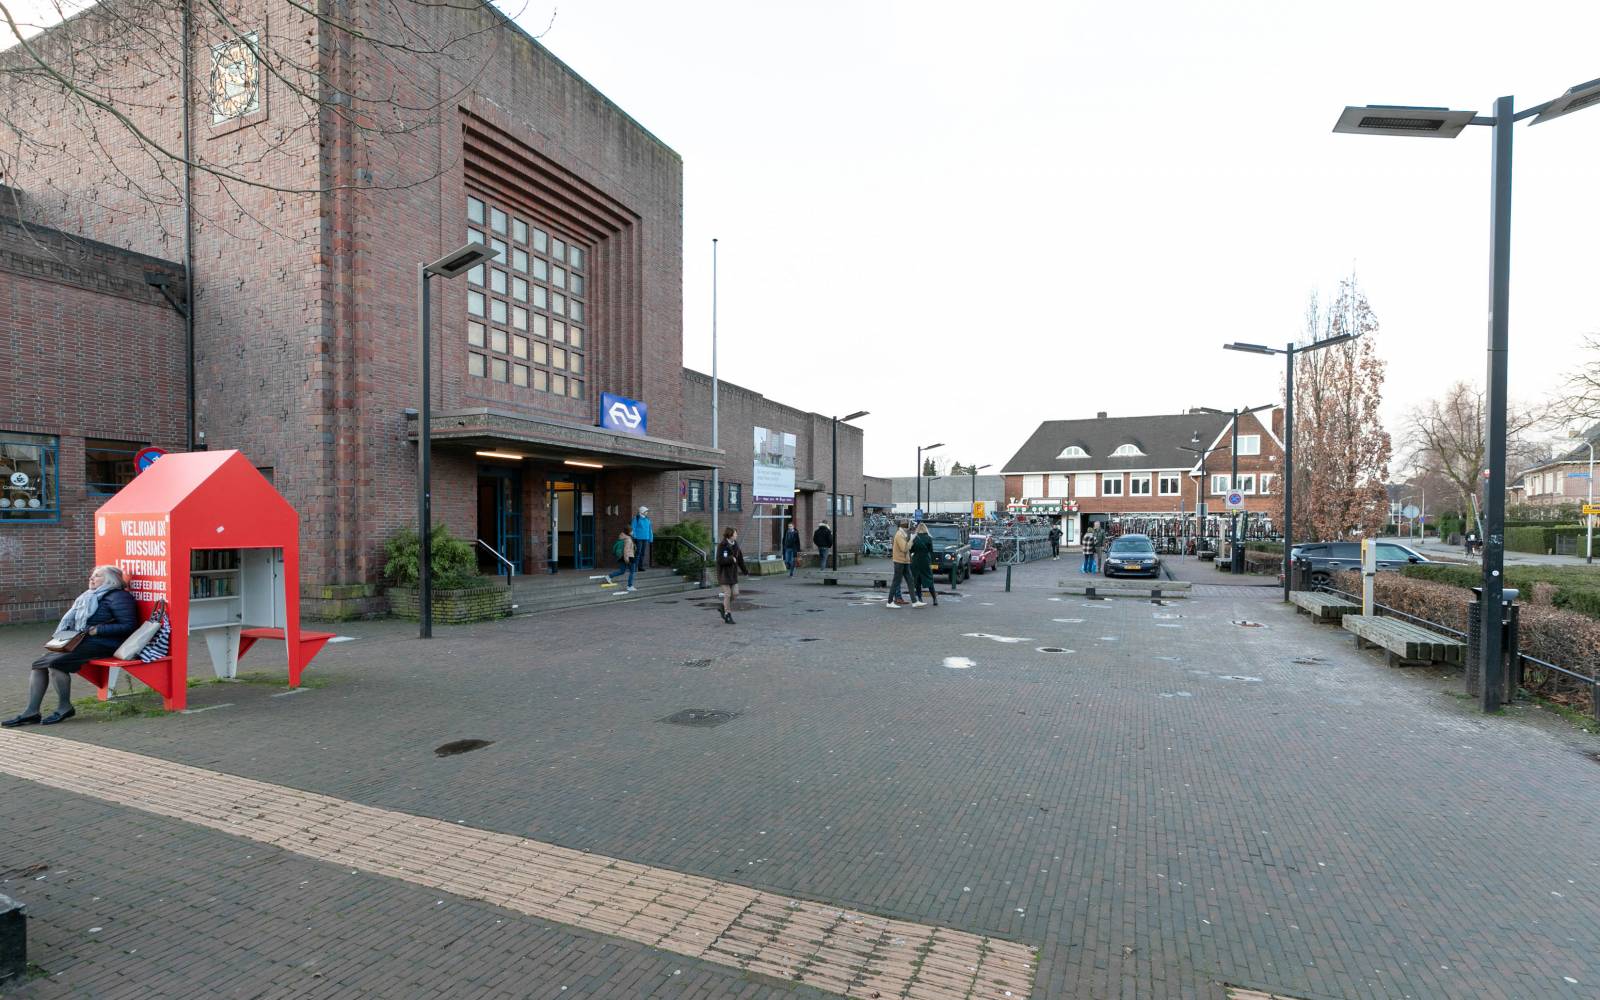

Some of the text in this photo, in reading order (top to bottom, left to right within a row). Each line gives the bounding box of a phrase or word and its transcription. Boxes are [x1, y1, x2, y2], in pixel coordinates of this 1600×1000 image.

[121, 520, 166, 537] WELKOM IN
[126, 540, 166, 556] BUSSUMS
